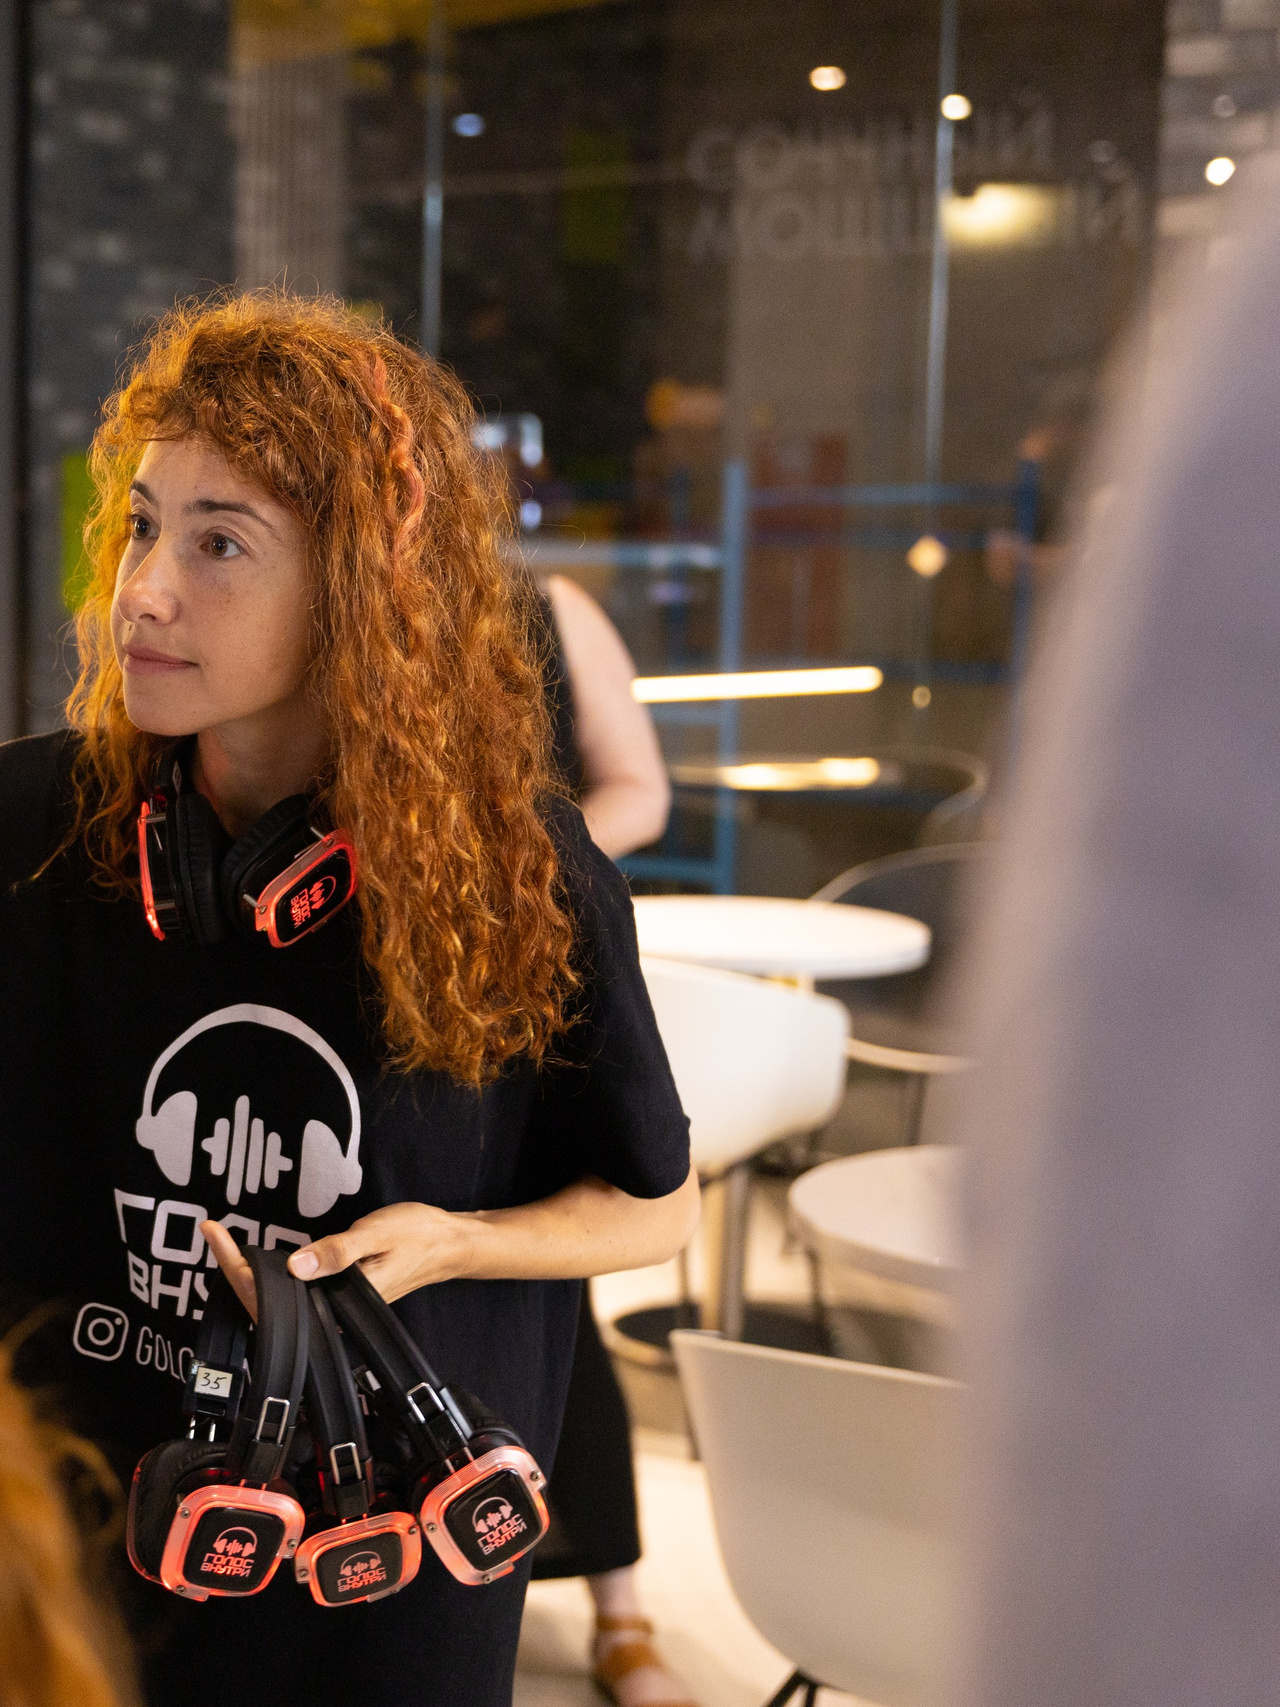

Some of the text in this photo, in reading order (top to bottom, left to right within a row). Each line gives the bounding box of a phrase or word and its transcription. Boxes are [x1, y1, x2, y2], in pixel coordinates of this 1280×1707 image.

[200, 1372, 228, 1390] 35
[477, 1513, 524, 1548] ГОЛОС
[482, 1521, 528, 1556] ВНУТРИ
[200, 1562, 252, 1578] ВНУТРИ
[203, 1552, 255, 1569] ГОЛОС
[337, 1566, 386, 1587] ГОЛОС
[338, 1573, 388, 1593] ВНУТРИ
